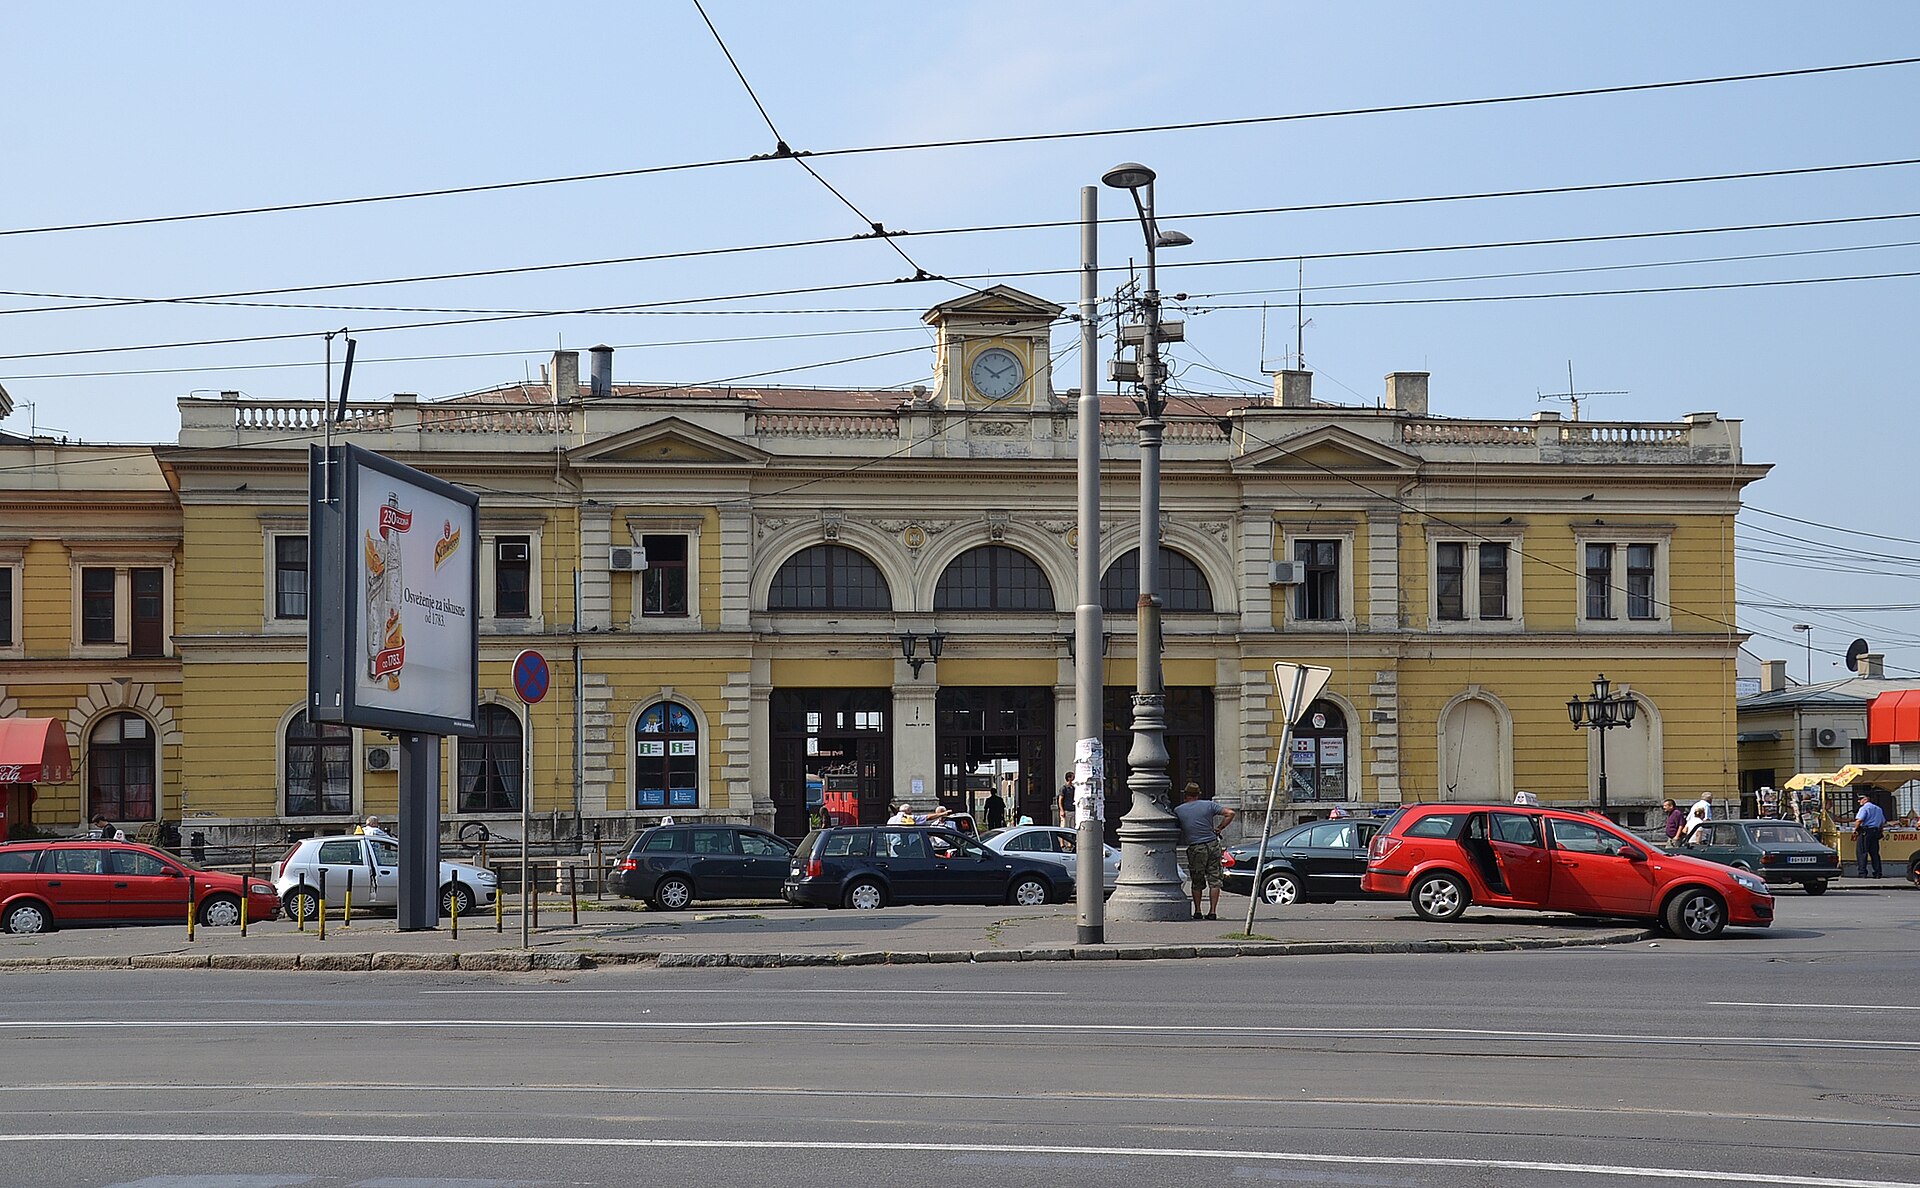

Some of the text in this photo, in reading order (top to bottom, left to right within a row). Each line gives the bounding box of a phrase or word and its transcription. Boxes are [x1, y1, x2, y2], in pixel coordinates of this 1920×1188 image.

[383, 509, 397, 525] 230
[404, 587, 466, 617] Osveženje za iskusne
[424, 610, 446, 627] od 1783.
[387, 653, 401, 667] 1783.
[1893, 833, 1918, 841] DINARA
